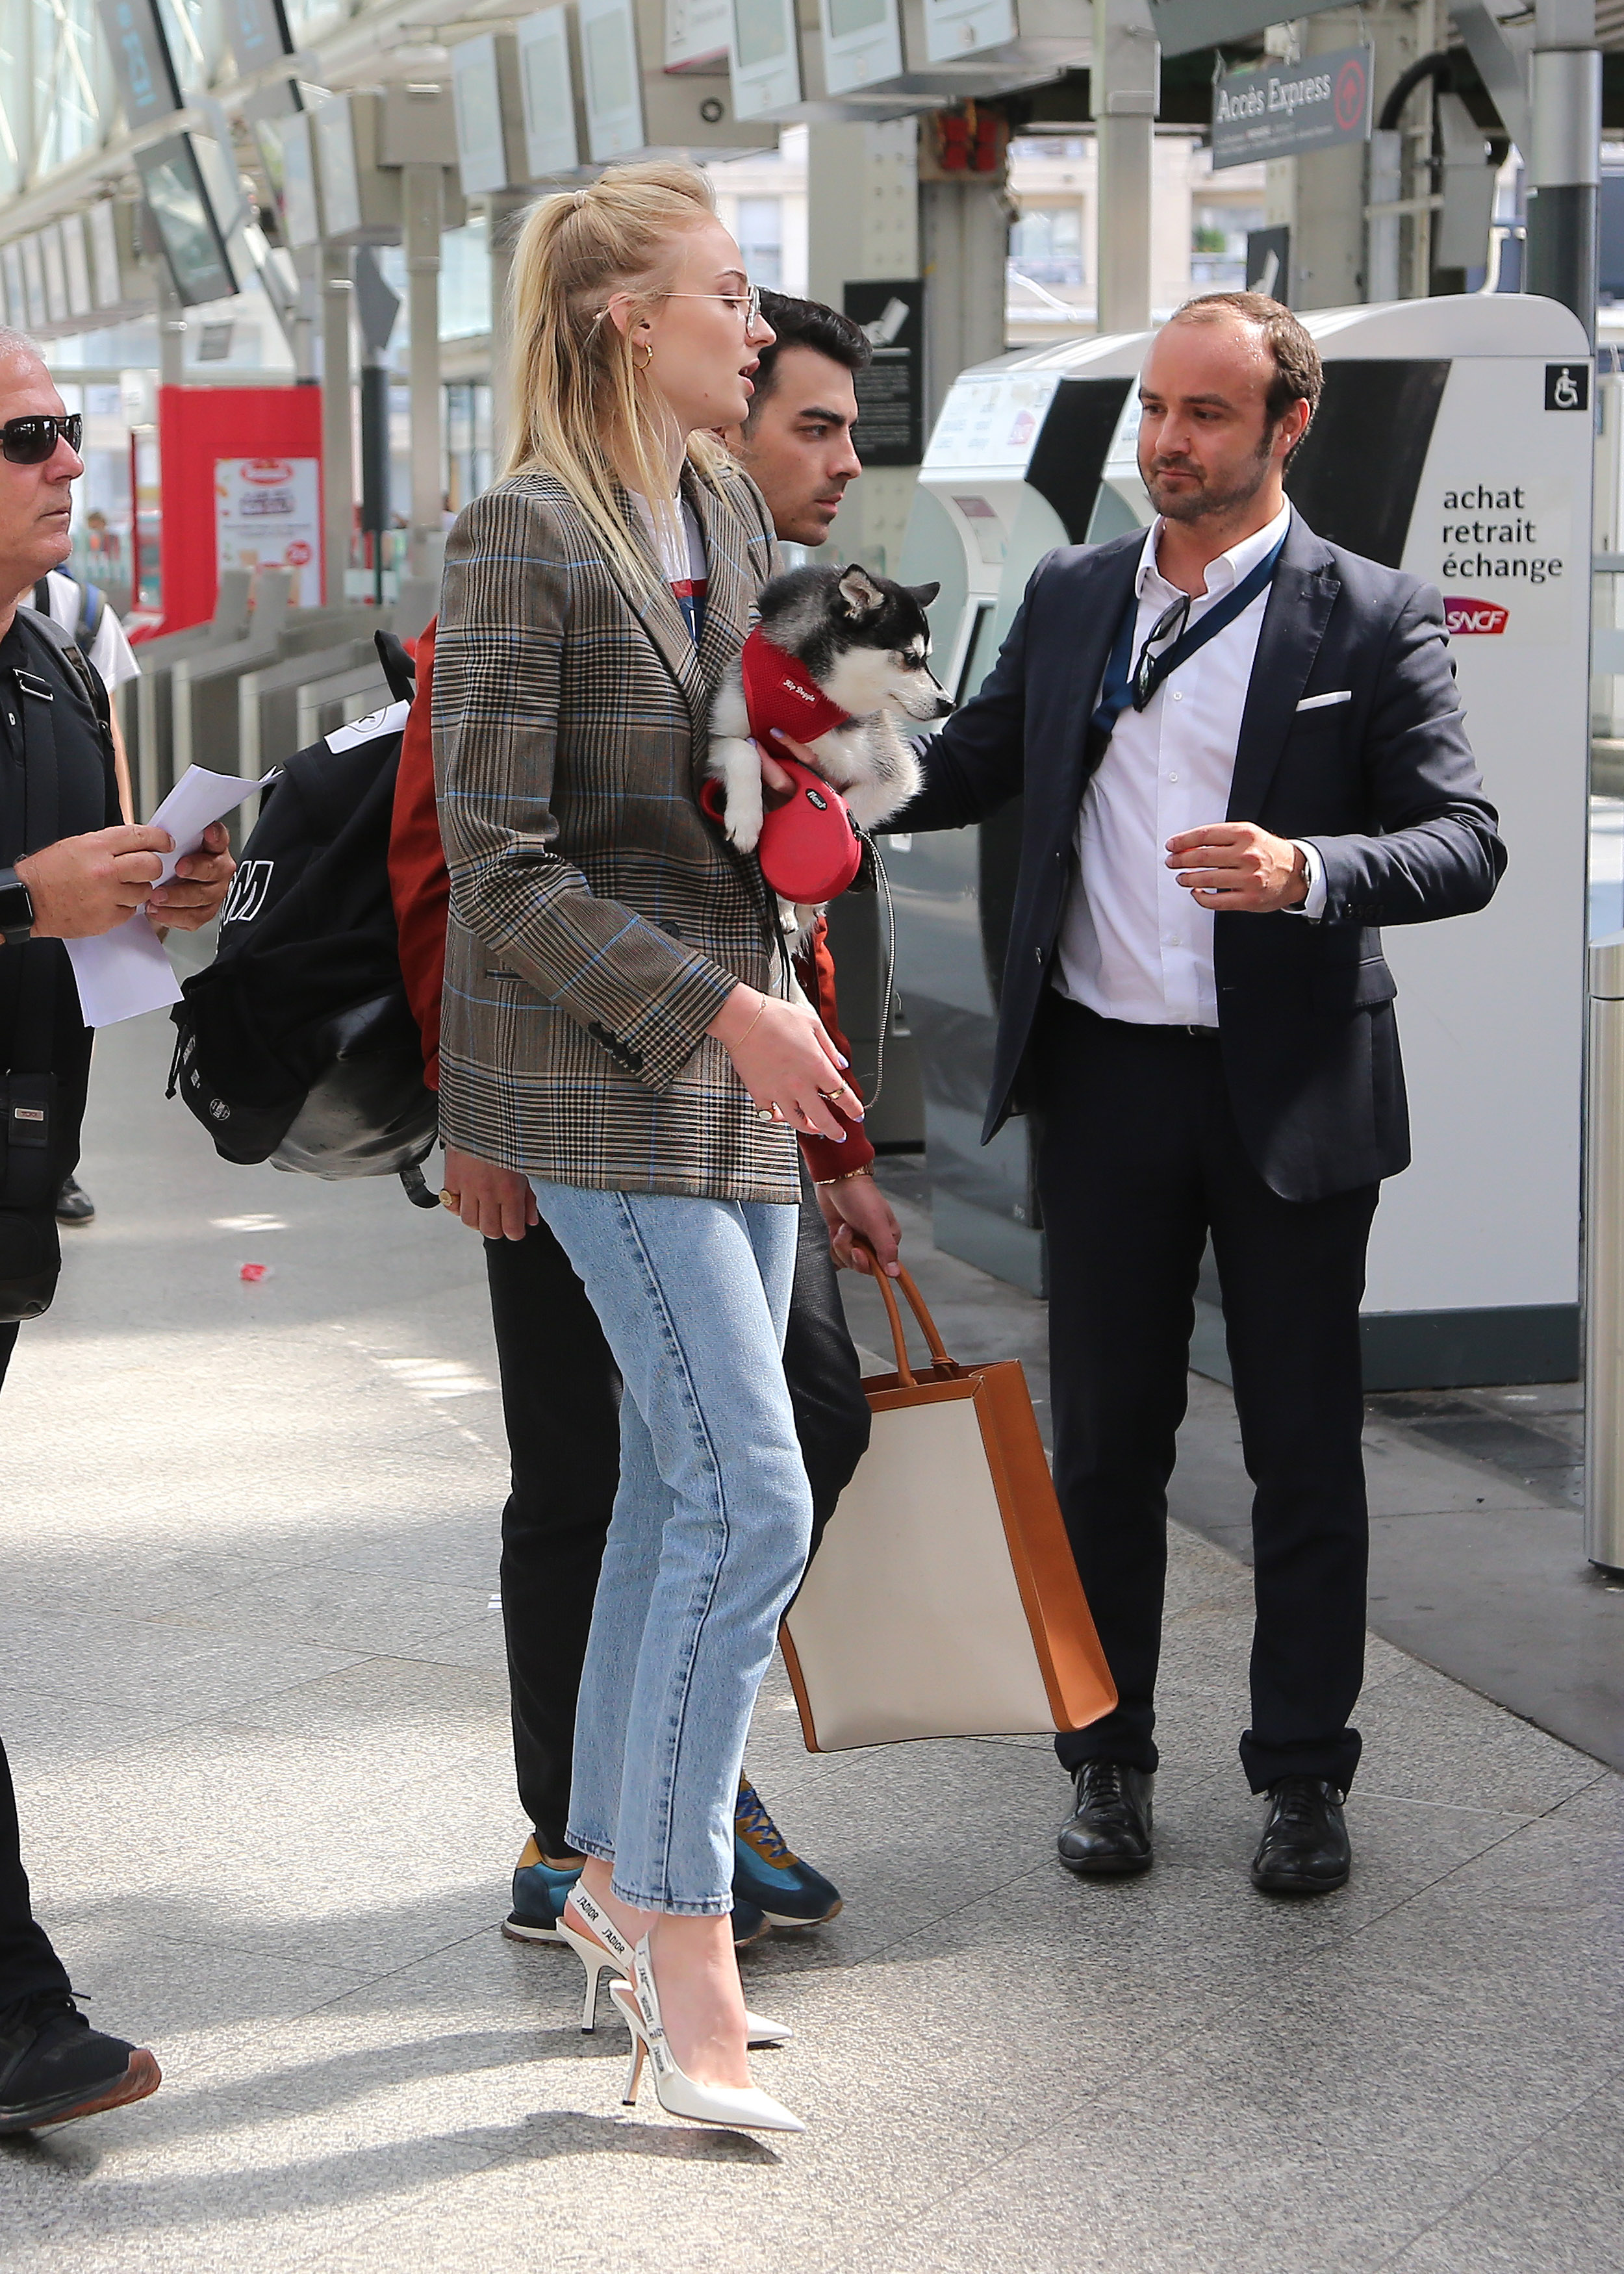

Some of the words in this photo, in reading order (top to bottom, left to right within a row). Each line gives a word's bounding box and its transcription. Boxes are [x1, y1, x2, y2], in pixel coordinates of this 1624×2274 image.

[1217, 84, 1265, 123] Accès
[1267, 74, 1332, 116] Express
[1443, 483, 1525, 509] achat
[1443, 518, 1536, 543] retrait
[1443, 551, 1563, 584] échange
[1446, 611, 1505, 632] SNCF
